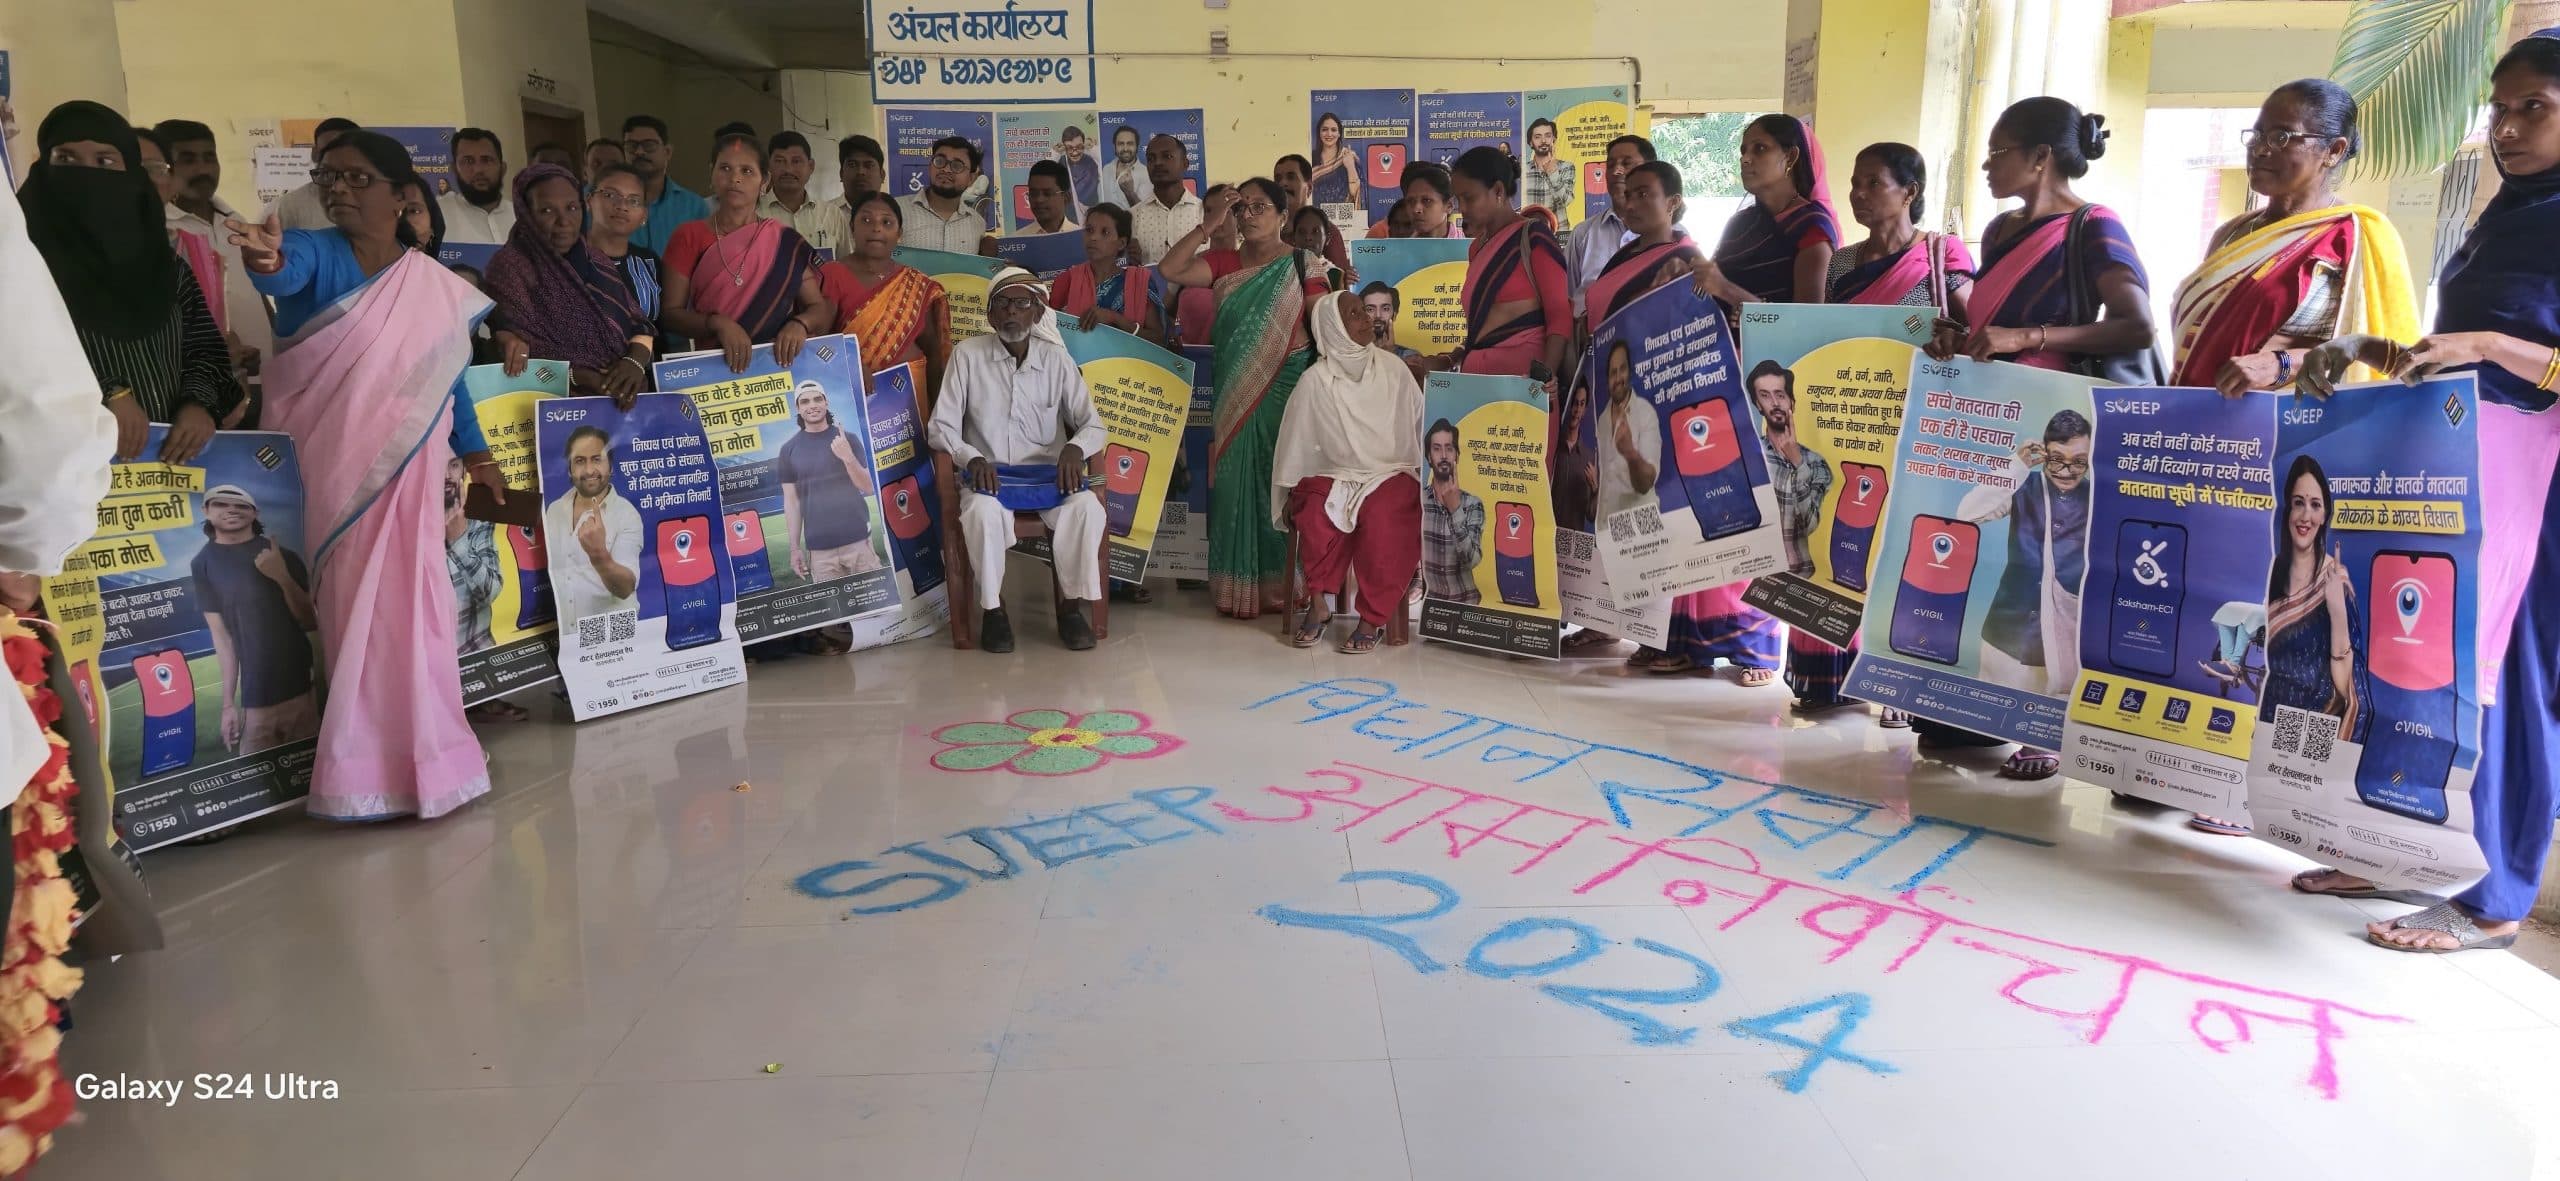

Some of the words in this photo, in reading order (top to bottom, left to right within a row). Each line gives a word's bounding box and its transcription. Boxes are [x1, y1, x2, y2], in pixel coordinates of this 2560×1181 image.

[887, 6, 961, 42] अंचल
[961, 0, 1068, 40] कार्यालय
[1357, 246, 1386, 254] SWEEP
[1746, 312, 1780, 324] SWEEP
[664, 367, 700, 381] SWEEP
[1836, 366, 1853, 383] धर्म,
[1855, 367, 1871, 384] वर्ग,
[1873, 369, 1896, 385] जाति,
[1921, 363, 1960, 379] SWEEP
[711, 385, 730, 401] वोट
[732, 381, 741, 398] है
[744, 376, 791, 396] अनमोल,
[1806, 384, 1837, 399] समुदाय,
[1839, 388, 1857, 398] भाषा
[1859, 389, 1883, 400] अथवा
[730, 406, 753, 426] तुम
[756, 396, 786, 417] कभी
[1927, 391, 1953, 410] सच्चे
[1954, 396, 2002, 419] मतदाता
[2003, 400, 2022, 421] की
[2104, 399, 2161, 415] SWEEP
[546, 409, 587, 423] SWEEP
[2283, 408, 2324, 425] SWEEP
[661, 436, 675, 450] एवं
[676, 431, 701, 449] प्रलोभन
[1920, 417, 1942, 435] एक
[1943, 418, 1958, 438] ही
[1958, 419, 1969, 440] है
[1971, 425, 2017, 451] पहचान,
[1833, 436, 1844, 448] का
[1845, 435, 1866, 450] प्रयोग
[1867, 437, 1884, 453] करें।
[1913, 441, 1941, 459] नकद,
[1943, 446, 1972, 463] शराब
[1972, 450, 1985, 466] या
[2121, 432, 2142, 448] अब
[2142, 430, 2162, 449] रही
[2164, 430, 2191, 451] नहीं
[2190, 433, 2215, 453] कोई
[2217, 436, 2263, 460] मजबूरी,
[639, 459, 664, 473] चुनाव
[666, 453, 677, 468] के
[1906, 460, 1935, 476] उपहार
[1936, 462, 1957, 479] बिन
[1958, 467, 1977, 483] करें
[2117, 452, 2141, 473] कोई
[2143, 455, 2159, 473] भी
[2160, 456, 2199, 478] दिव्यांग
[2202, 463, 2214, 478] न
[2216, 461, 2241, 481] रखे
[628, 475, 638, 491] में
[639, 472, 677, 491] जिम्मेदार
[678, 469, 710, 487] नागरिक
[2328, 476, 2372, 495] जागरूक
[2373, 469, 2393, 495] और
[2395, 470, 2425, 496] सतर्क
[2427, 476, 2468, 496] मतदाता
[1705, 484, 1734, 499] cVIGIL
[2118, 479, 2166, 500] मतदाता
[2167, 482, 2196, 508] सूची
[2197, 484, 2216, 505] में
[639, 494, 653, 510] की
[654, 492, 686, 512] भूमिका
[120, 504, 145, 531] तुम
[145, 494, 185, 521] कभी
[2336, 502, 2375, 525] लोकतंत्र
[2377, 503, 2389, 525] के
[2392, 509, 2421, 528] भाग्य
[2423, 504, 2459, 529] विधाता
[682, 599, 707, 610] cVIGIL
[1632, 590, 1649, 600] 1950
[1913, 607, 1945, 622] cVIGIL
[2117, 597, 2175, 615] Saksham-ECI
[738, 622, 759, 634] 1950
[1871, 684, 1897, 697] 1950
[598, 698, 619, 709] 1950
[2089, 761, 2116, 775] 1950
[148, 815, 178, 834] 1950
[2280, 831, 2302, 844] 1950
[1211, 758, 1611, 877] आम
[1574, 834, 2416, 1101] निर्वाचन
[1254, 867, 1901, 1095] 2024
